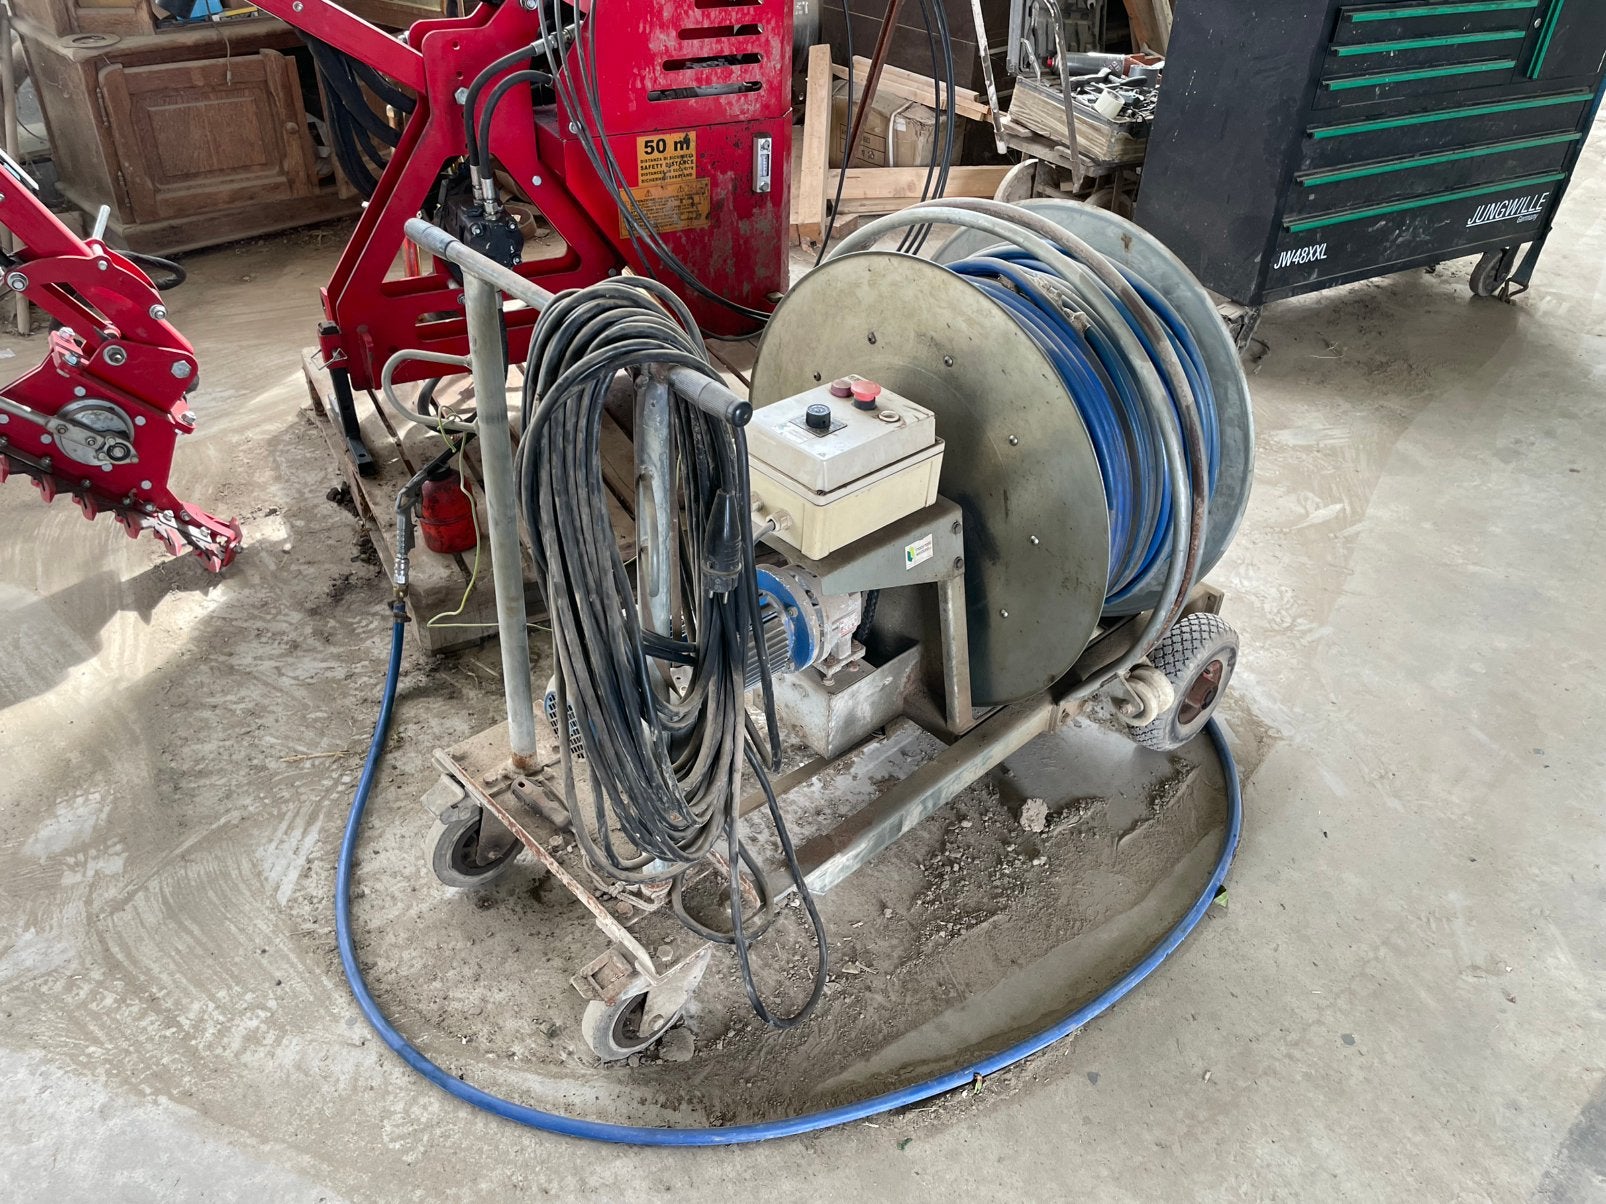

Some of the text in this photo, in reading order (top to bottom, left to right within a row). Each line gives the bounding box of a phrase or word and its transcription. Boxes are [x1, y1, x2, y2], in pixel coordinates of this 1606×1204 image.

[644, 138, 667, 155] 50
[640, 159, 694, 171] SAFETY DISTANCE
[1467, 192, 1550, 225] JUNGWILLE
[1273, 243, 1327, 270] JW48XXL
